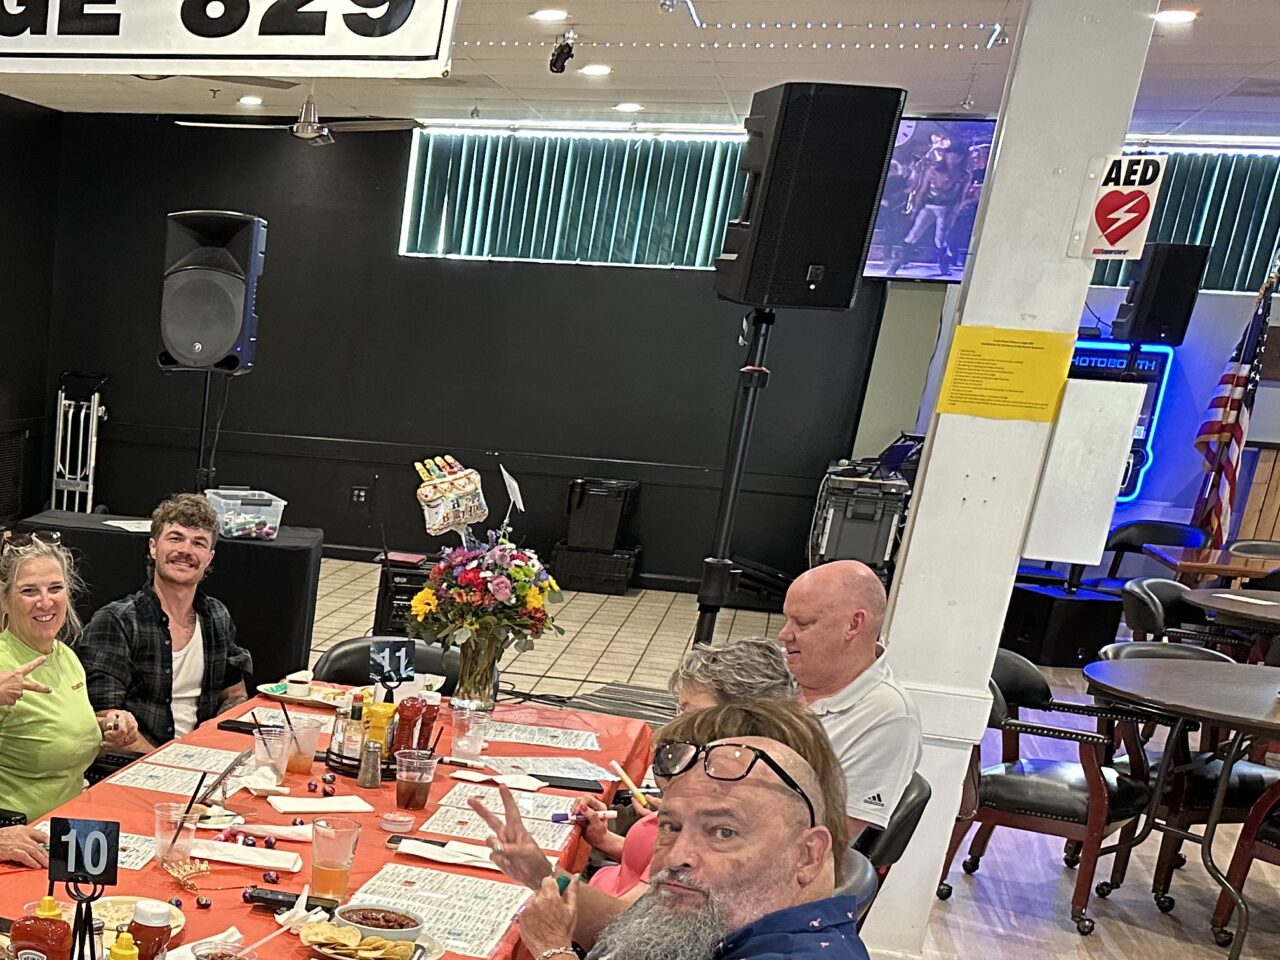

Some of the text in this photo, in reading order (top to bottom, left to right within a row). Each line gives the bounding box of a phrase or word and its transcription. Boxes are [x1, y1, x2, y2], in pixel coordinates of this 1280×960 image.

[1101, 159, 1161, 186] AED
[1071, 356, 1156, 370] HOTOBOTH
[376, 647, 408, 673] 11
[863, 799, 884, 807] adidas
[61, 828, 109, 875] 10
